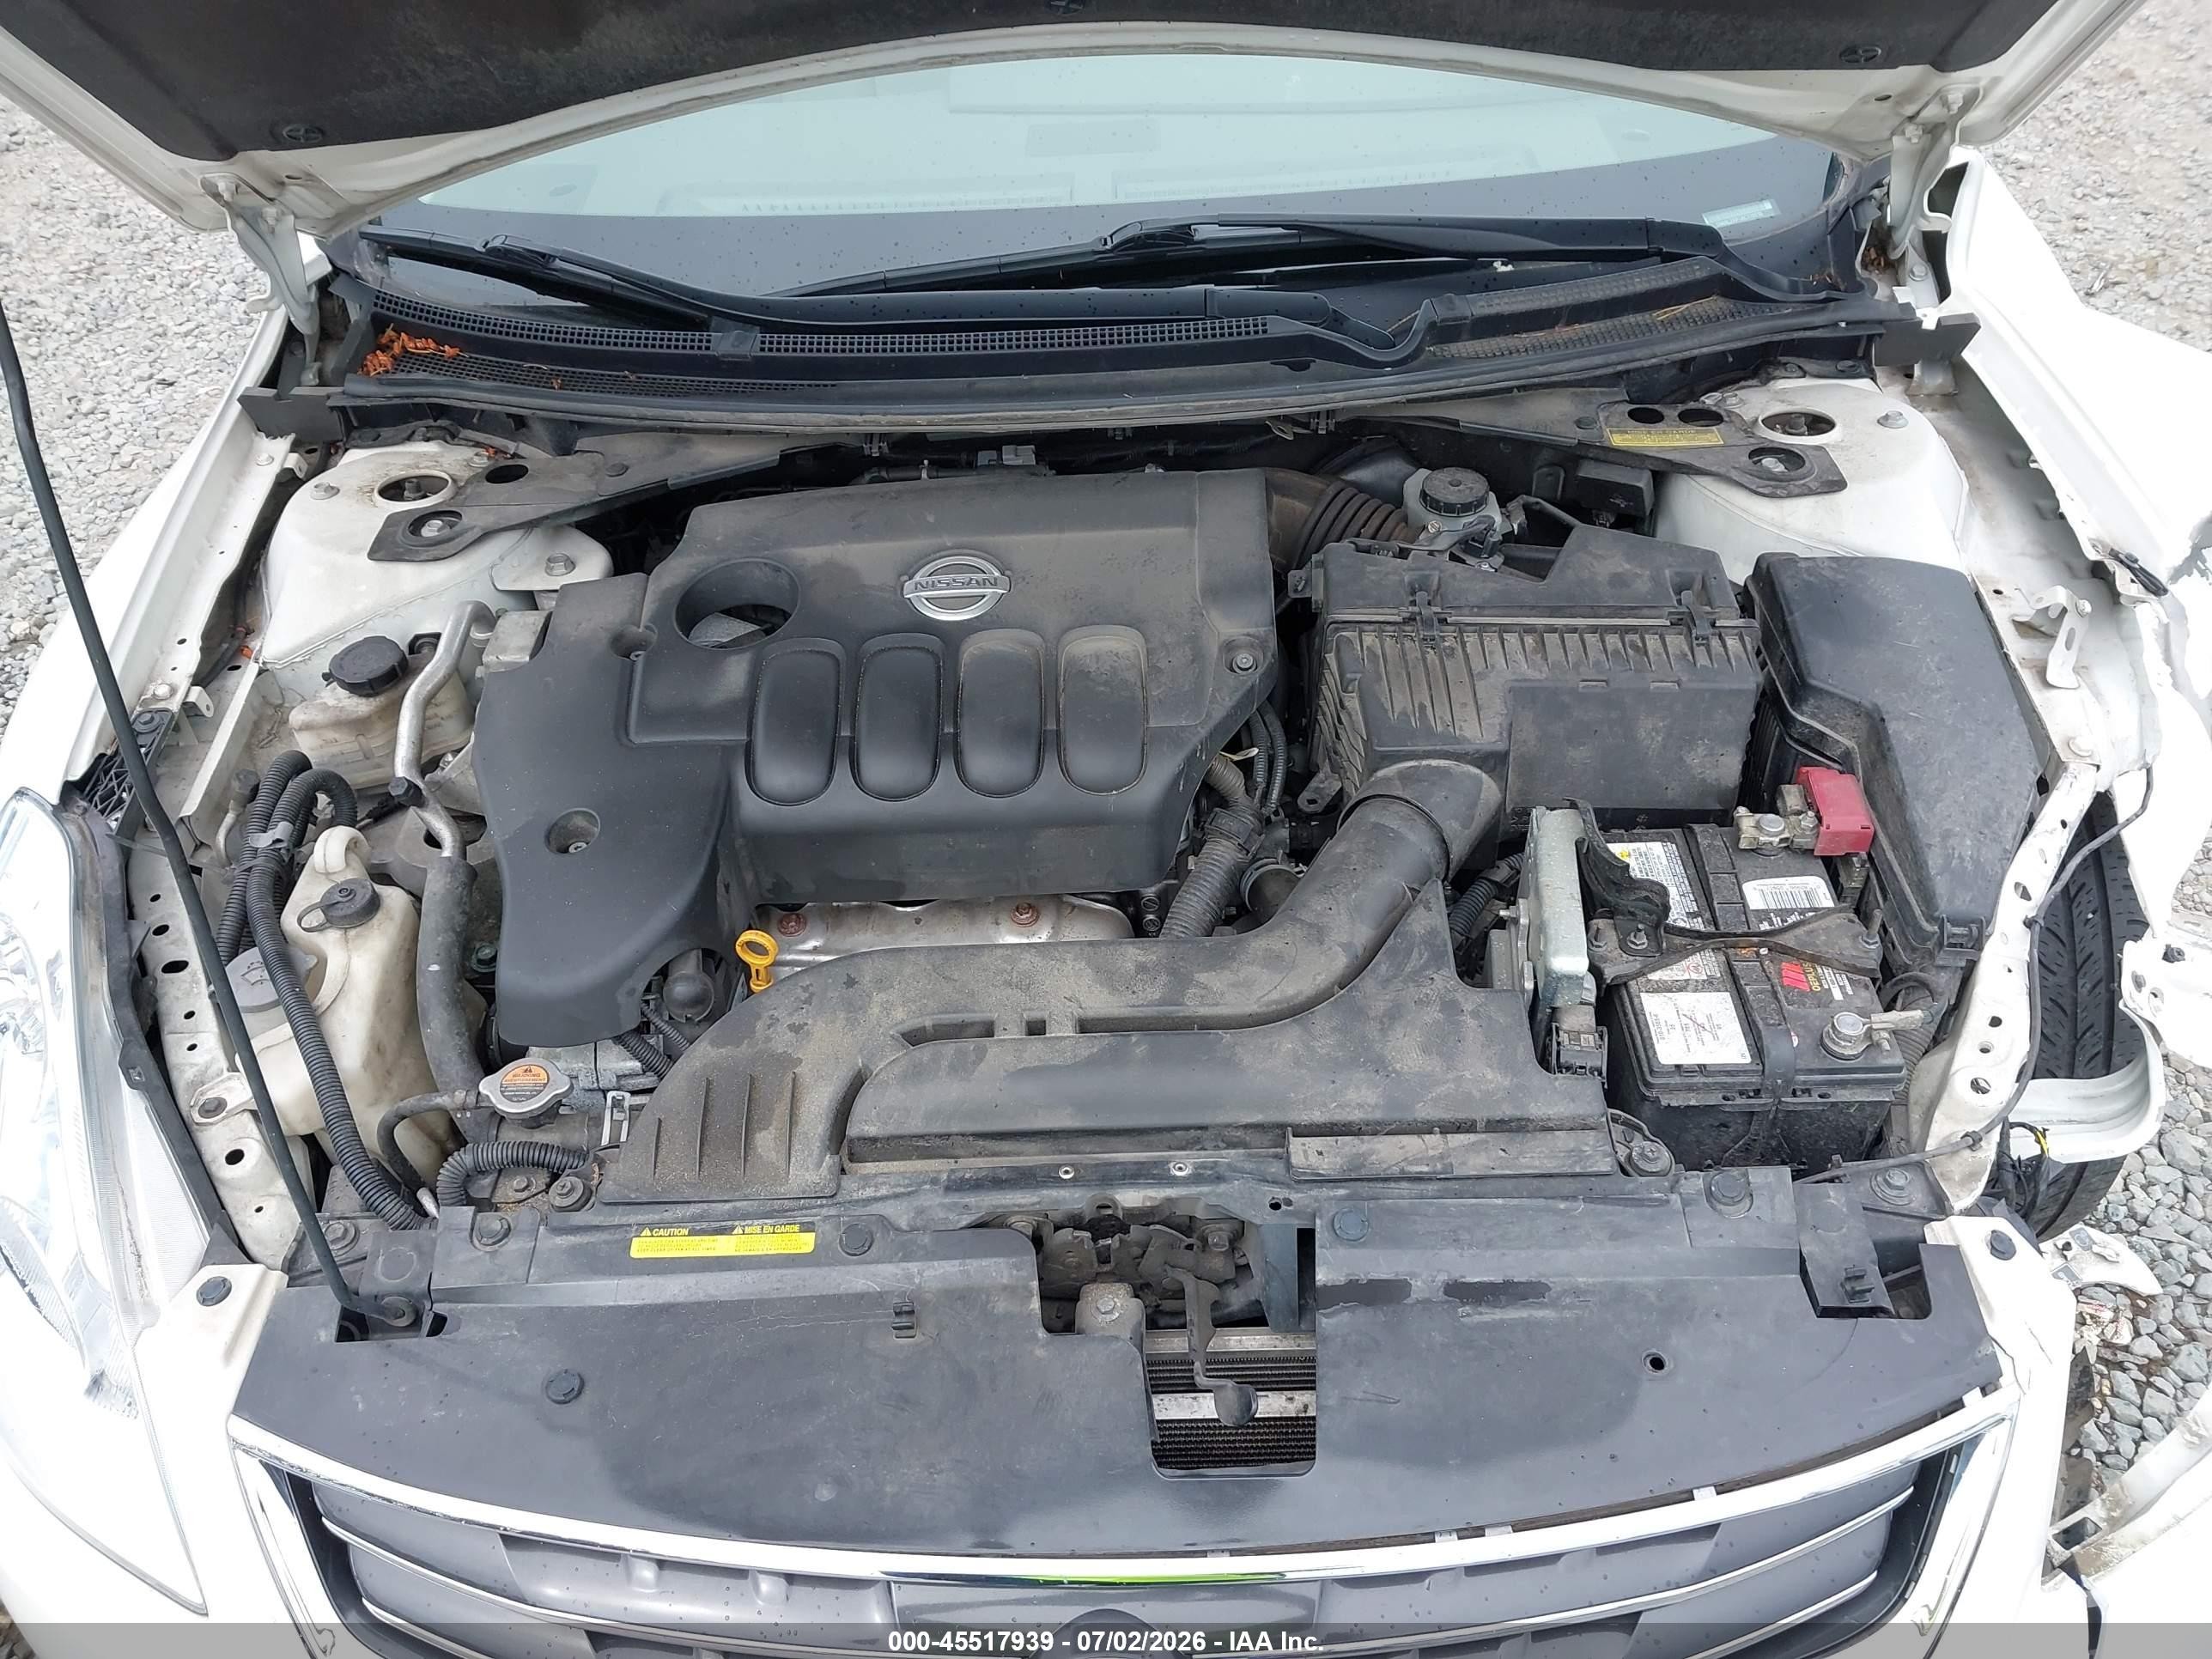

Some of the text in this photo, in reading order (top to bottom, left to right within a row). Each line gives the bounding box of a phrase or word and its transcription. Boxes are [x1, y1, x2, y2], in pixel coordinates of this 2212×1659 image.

[914, 576, 999, 591] NISSAN
[653, 1228, 690, 1237] CAUTION
[744, 1224, 800, 1234] MISE EN GARDE
